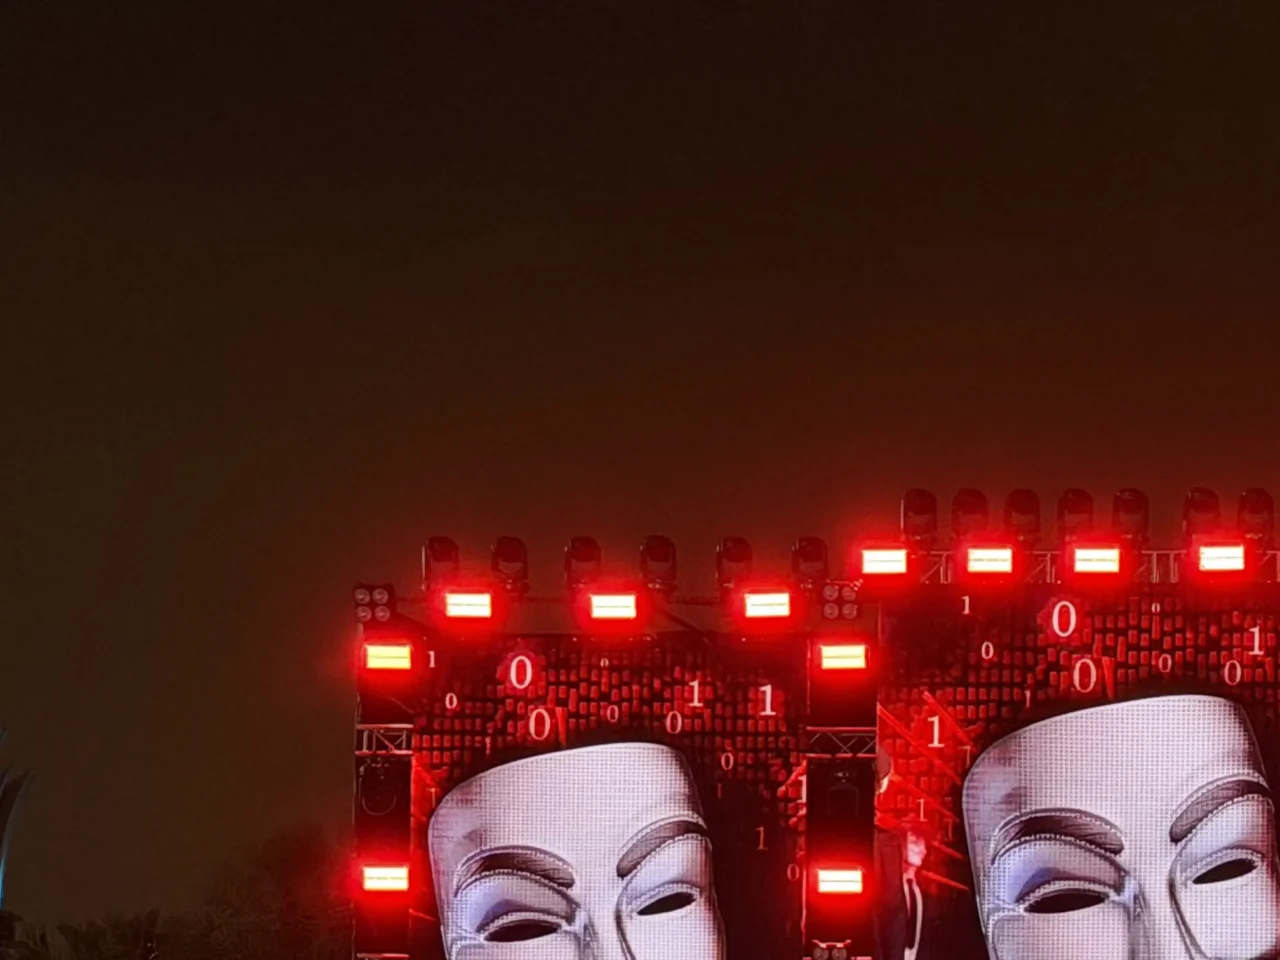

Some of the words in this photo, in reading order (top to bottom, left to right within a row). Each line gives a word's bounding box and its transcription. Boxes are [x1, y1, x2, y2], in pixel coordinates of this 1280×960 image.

[962, 595, 971, 615] 1
[1052, 600, 1076, 637] 0
[981, 641, 994, 659] 0
[1249, 626, 1264, 655] 1
[428, 651, 436, 668] 1
[1159, 654, 1172, 672] 0
[510, 655, 532, 689] 0
[1073, 658, 1097, 693] 0
[1224, 660, 1242, 685] 0
[445, 693, 457, 709] 0
[688, 679, 704, 707] 1
[759, 684, 777, 716] 1
[1025, 690, 1031, 708] 1
[529, 708, 550, 740] 0
[607, 705, 619, 723] 0
[666, 711, 682, 734] 0
[927, 715, 945, 747] 1
[485, 736, 491, 754] 1
[721, 752, 734, 770] 0
[797, 774, 807, 803] 1
[917, 798, 928, 821] 1
[756, 826, 768, 850] 1
[787, 864, 799, 881] 0
